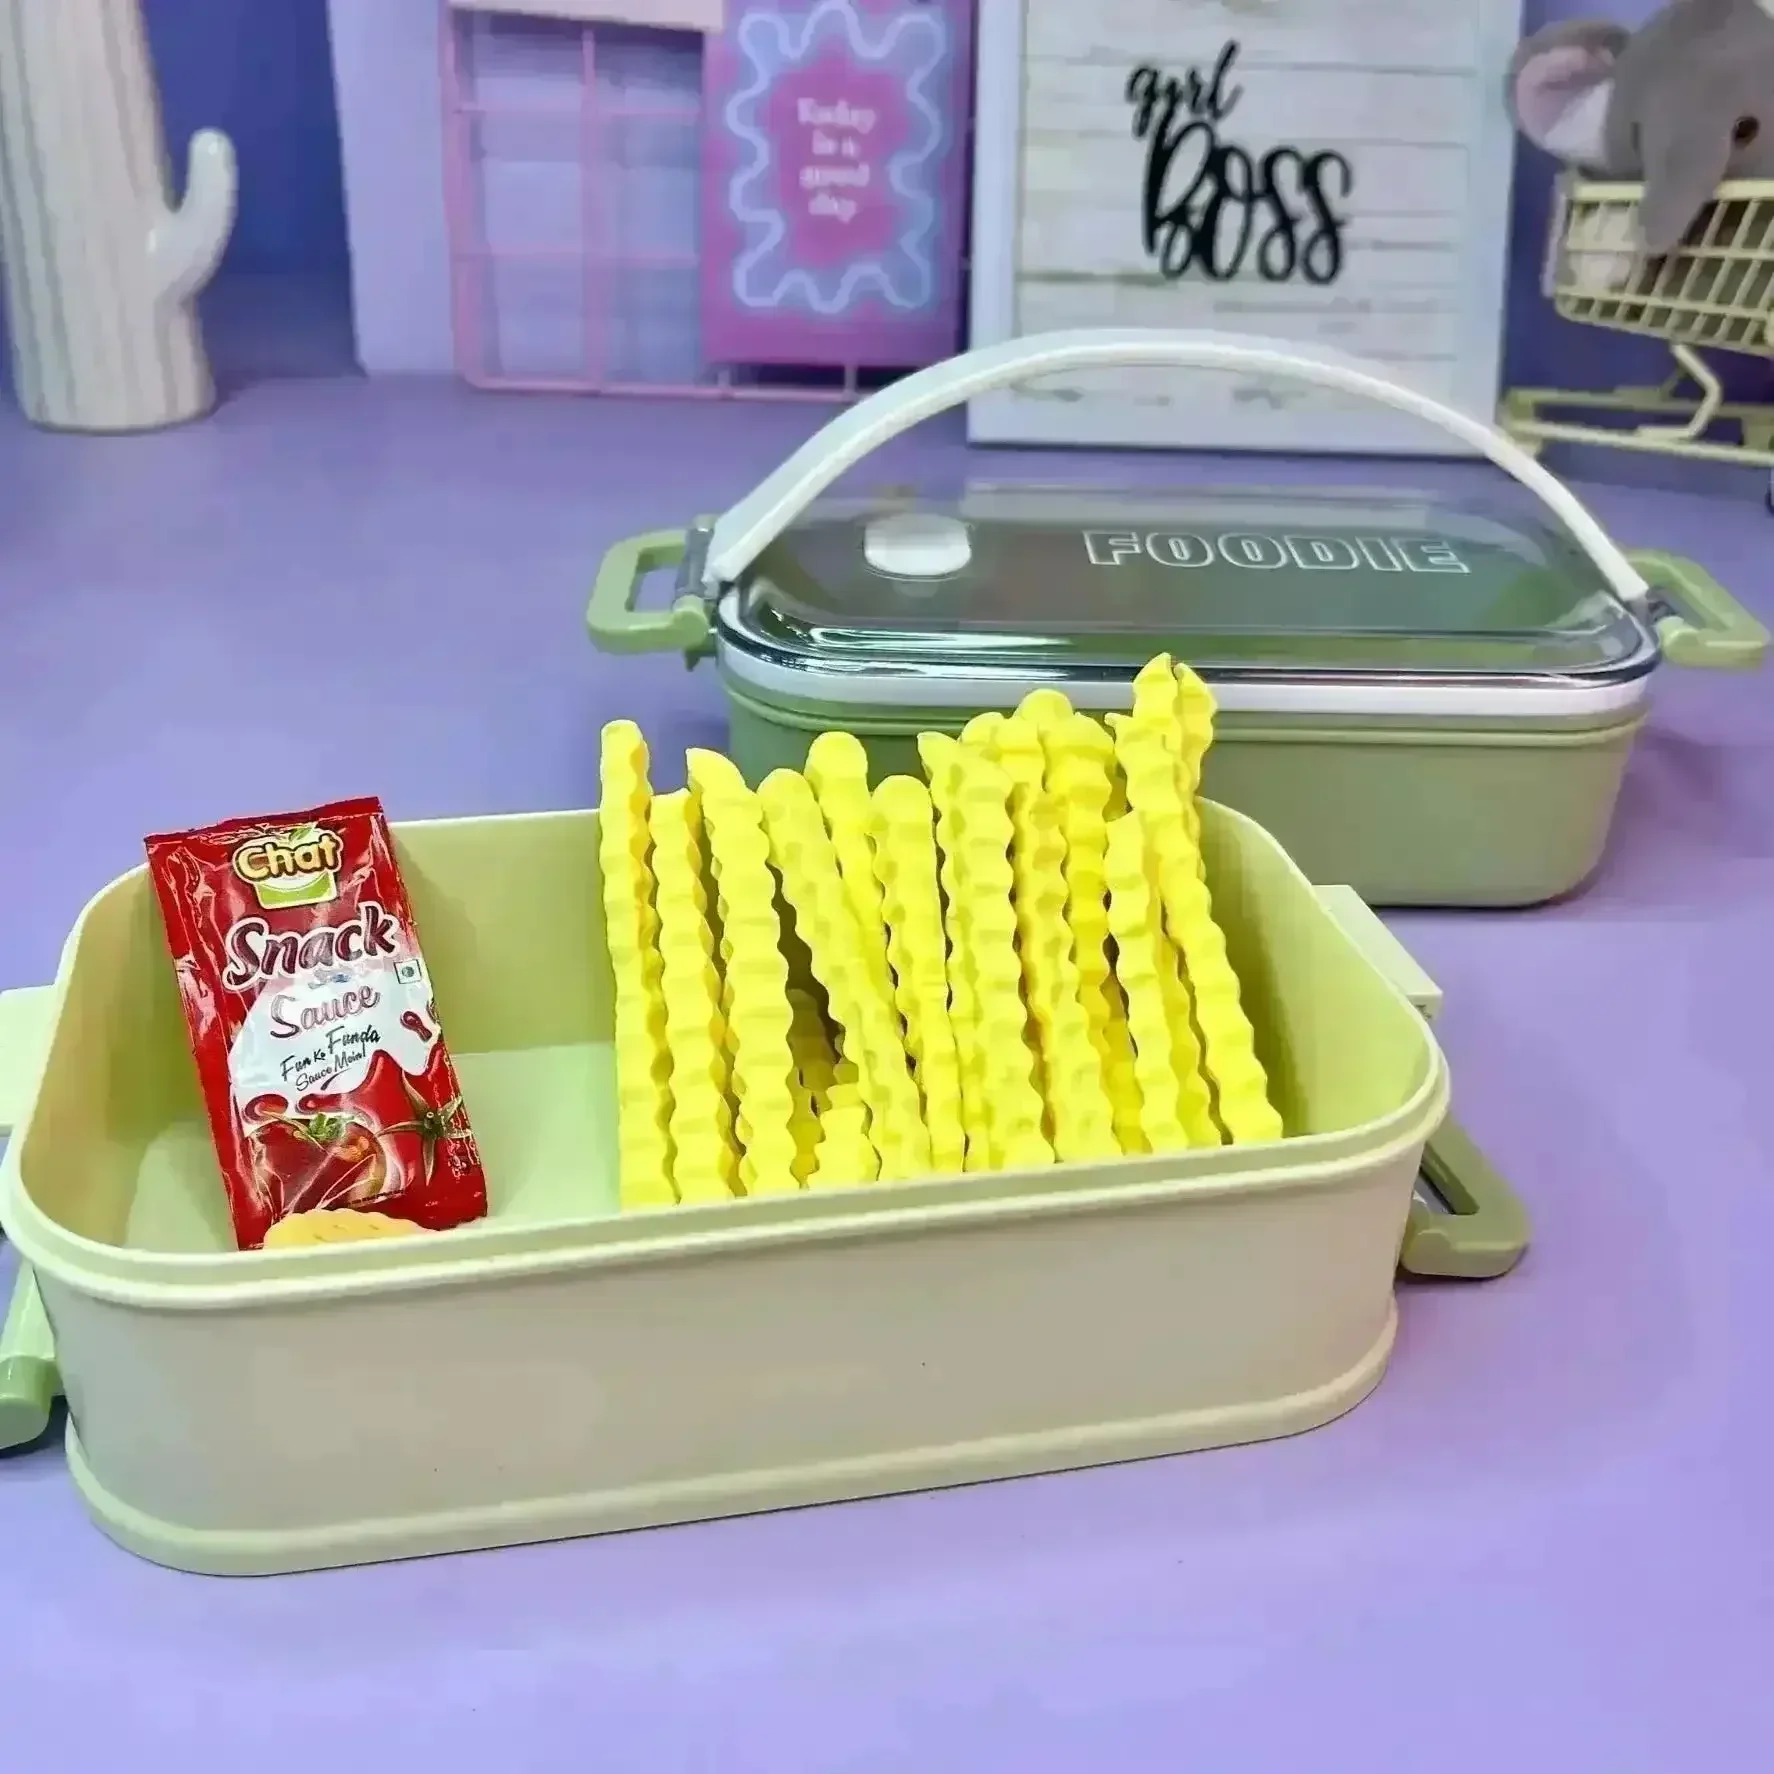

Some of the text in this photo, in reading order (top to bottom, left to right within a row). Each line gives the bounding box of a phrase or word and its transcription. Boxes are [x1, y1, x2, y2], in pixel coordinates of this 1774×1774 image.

[1124, 38, 1244, 140] girl
[1082, 529, 1471, 574] FOODIE
[235, 832, 339, 882] Chat
[224, 902, 398, 989] Snack
[269, 985, 382, 1039] Sauce
[279, 1054, 312, 1082] Fun
[324, 1024, 381, 1055] Funda
[295, 1066, 333, 1092] Sauce
